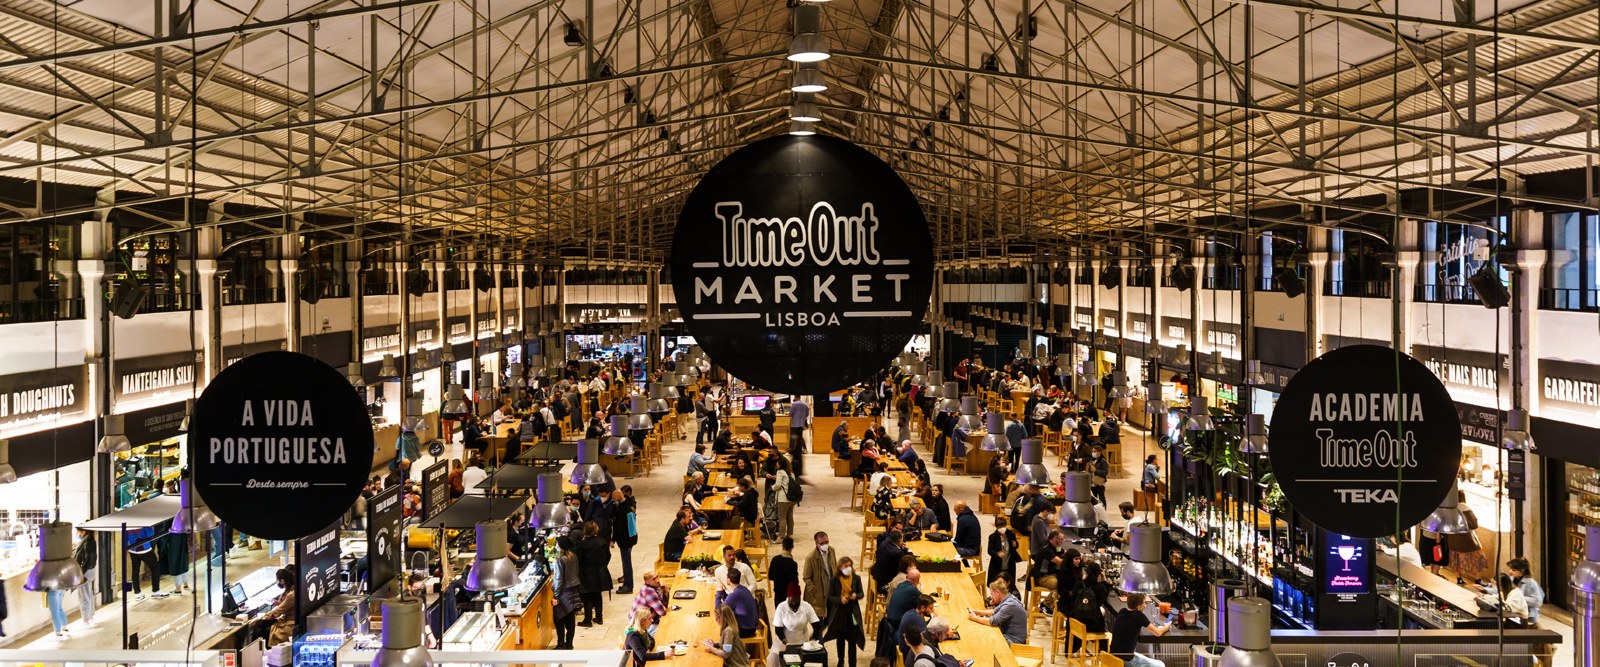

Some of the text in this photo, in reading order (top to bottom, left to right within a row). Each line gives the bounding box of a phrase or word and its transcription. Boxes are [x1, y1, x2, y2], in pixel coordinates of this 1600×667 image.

[715, 201, 880, 267] Time Out
[694, 273, 910, 305] MARKET
[765, 312, 840, 327] LISBOA
[122, 367, 175, 395] MANTEIGARIA
[1449, 362, 1469, 386] MAIS
[13, 383, 75, 415] DOUGHNUTS
[1309, 393, 1424, 422] ACADEMIA
[242, 400, 313, 426] A VIDA
[1461, 424, 1495, 442] AVLOVA
[209, 437, 346, 464] PORTUGUESA
[1316, 428, 1417, 468] Time Out
[246, 478, 309, 489] Desde sempre
[1335, 489, 1398, 503] TEKA
